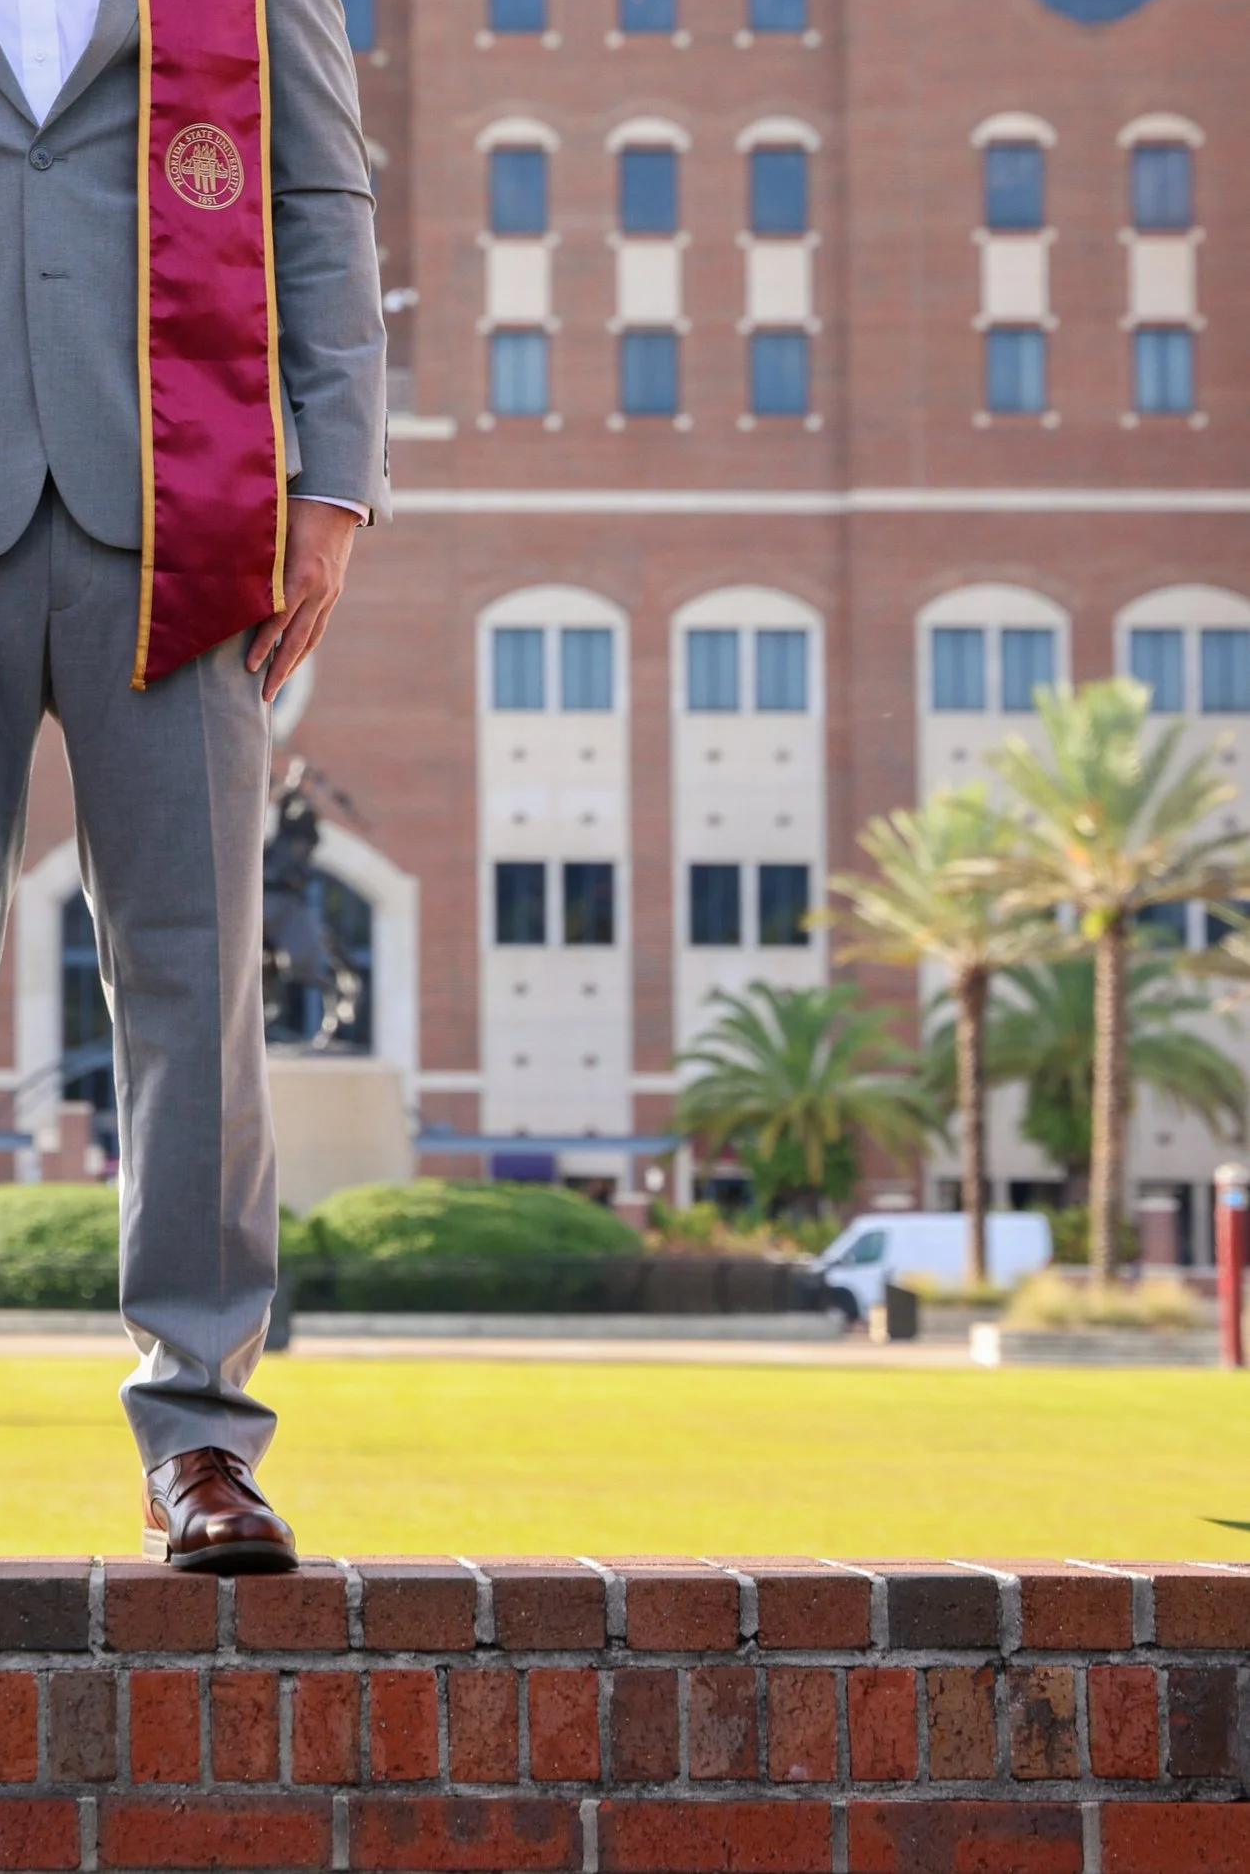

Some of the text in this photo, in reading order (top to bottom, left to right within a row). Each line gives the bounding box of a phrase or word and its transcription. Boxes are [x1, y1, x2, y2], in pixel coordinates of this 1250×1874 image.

[171, 129, 239, 194] FLORIDA STATE UNIVERSITY
[198, 195, 218, 205] 1851
